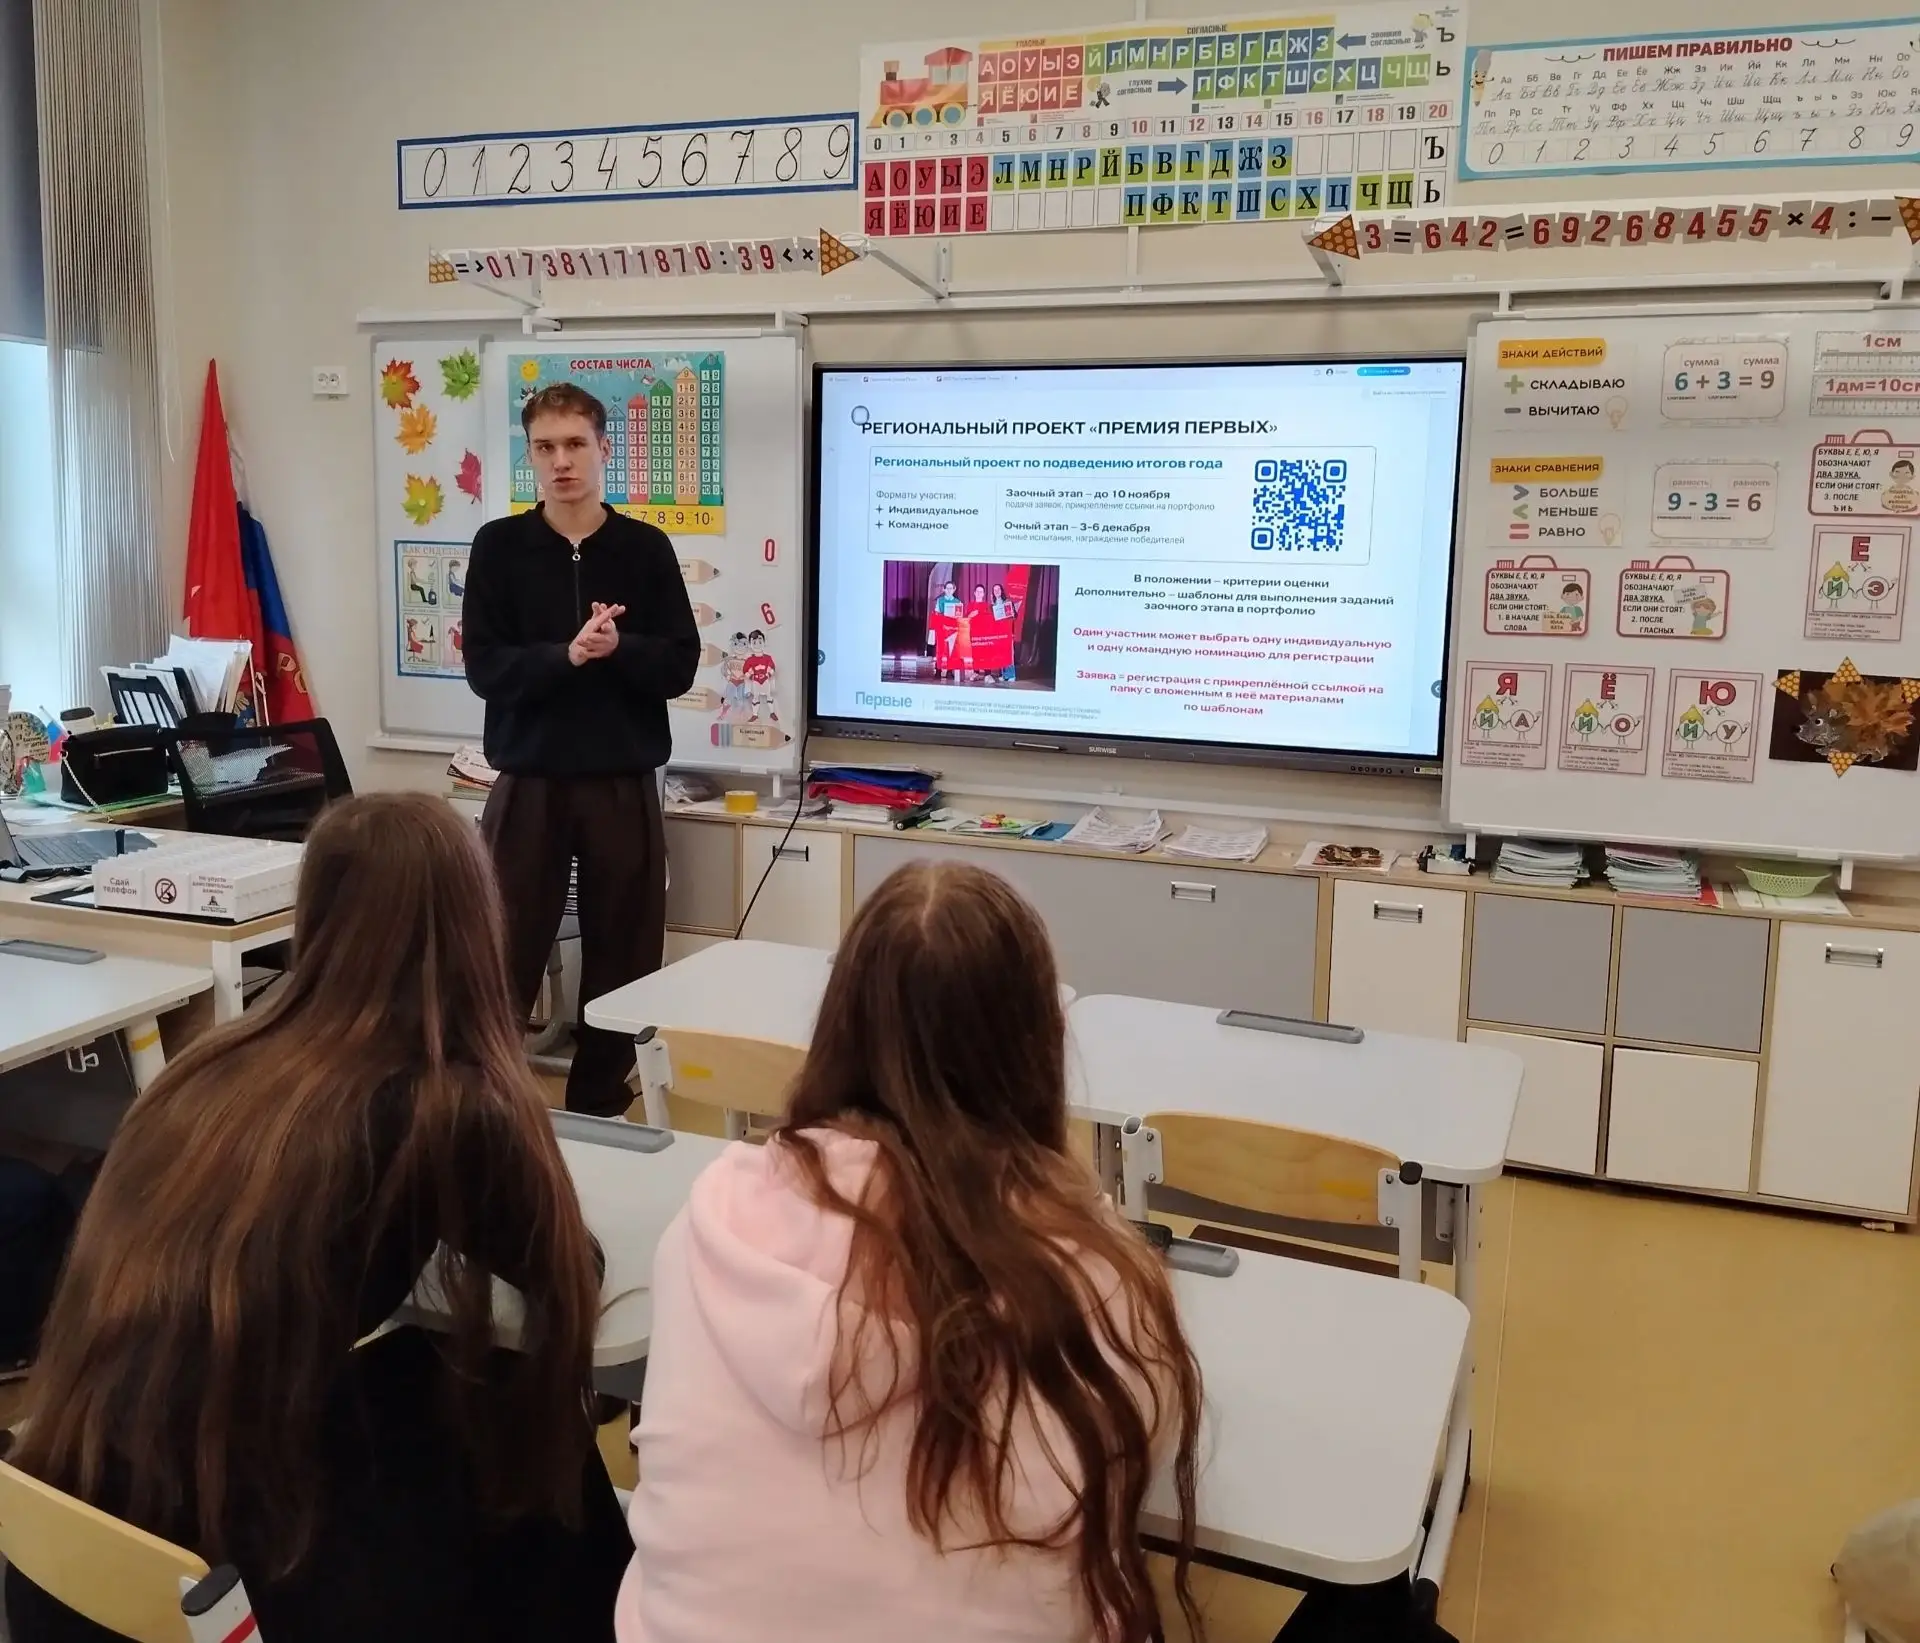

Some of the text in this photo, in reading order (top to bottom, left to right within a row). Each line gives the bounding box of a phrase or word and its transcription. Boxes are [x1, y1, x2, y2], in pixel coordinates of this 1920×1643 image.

[1187, 24, 1227, 34] СОГЛАСНЫЕ
[1370, 38, 1411, 46] СОГЛАСНЫЕ
[1603, 37, 1792, 61] ПИШЕМ ПРАВИЛЬНО
[1117, 87, 1152, 95] СОГЛАСНЫЕ
[424, 125, 849, 197] 0 1 2 3 4 5 6 7 8 9
[1502, 346, 1602, 358] ЗНАКИ ДЕЙСТВИЙ
[571, 359, 651, 369] СОСТАВ ЧИСЛА
[1684, 359, 1719, 368] сумма
[1743, 358, 1779, 366] сумма
[1530, 379, 1624, 389] СКЛАДЫВАЮ
[1675, 372, 1688, 391] 6
[1717, 371, 1730, 389] 3
[1761, 370, 1774, 388] 9
[1529, 406, 1599, 416] ВЫЧИТАЮ
[862, 419, 1277, 435] РЕГИОНАЛЬНЫЙ ПРОЕКТ «ПРЕМИЯ ПЕРВЫХ»
[875, 457, 1222, 470] Региональный проект по подведению итогов года
[1495, 464, 1599, 473] ЗНАКИ СРАВНЕНИЯ
[876, 490, 956, 500] Форматы участия:
[1006, 488, 1055, 498] Заочный
[1113, 490, 1125, 498] 10
[1128, 490, 1170, 500] ноября
[1540, 488, 1598, 497] БОЛЬШЕ
[1065, 502, 1122, 510] прикрепление
[1168, 503, 1214, 511] портфолио
[1668, 493, 1681, 511] 9
[1704, 493, 1718, 511] 3
[1748, 493, 1761, 512] 6
[889, 506, 978, 515] Индивидуальное
[1538, 507, 1598, 516] МЕНЬШЕ
[888, 520, 949, 530] Командное
[1005, 521, 1040, 530] Очный
[1080, 523, 1099, 531] 3-6
[1102, 524, 1150, 533] декабря
[1538, 528, 1585, 536] РАВНО
[1131, 536, 1185, 544] победителей
[1851, 536, 1870, 561] Е
[1144, 576, 1211, 584] положении
[1223, 579, 1281, 588] критерии
[1284, 580, 1329, 588] оценки
[1868, 581, 1884, 596] Э
[1075, 587, 1394, 605] Дополнительно шаблоны для выполнения заданий
[761, 602, 776, 626] 6
[1144, 602, 1198, 611] заочного
[1201, 604, 1234, 612] этапа
[1247, 606, 1315, 616] портфолио
[1074, 628, 1391, 649] Один участник может выбрать одну индивидуальную
[1097, 645, 1123, 653] одну
[1126, 646, 1191, 655] командную
[1195, 649, 1266, 658] номинацию
[1268, 651, 1290, 660] для
[1293, 653, 1374, 664] регистрации
[1077, 670, 1116, 680] Заявка
[1127, 674, 1201, 685] регистрация
[1213, 680, 1308, 690] прикреплённой
[1312, 683, 1365, 693] ссылкой
[1496, 673, 1518, 696] Я
[1601, 673, 1616, 700] Ё
[1110, 685, 1142, 695] папку
[1154, 688, 1222, 698] вложенным
[1260, 693, 1343, 704] материалами
[1699, 681, 1736, 706] Ю
[856, 691, 912, 710] Первые
[1184, 703, 1263, 714] по шаблонам
[1515, 713, 1529, 727] А
[1615, 717, 1630, 732] О
[1722, 725, 1737, 739] У
[110, 877, 129, 886] Сдай
[103, 886, 137, 895] телефон
